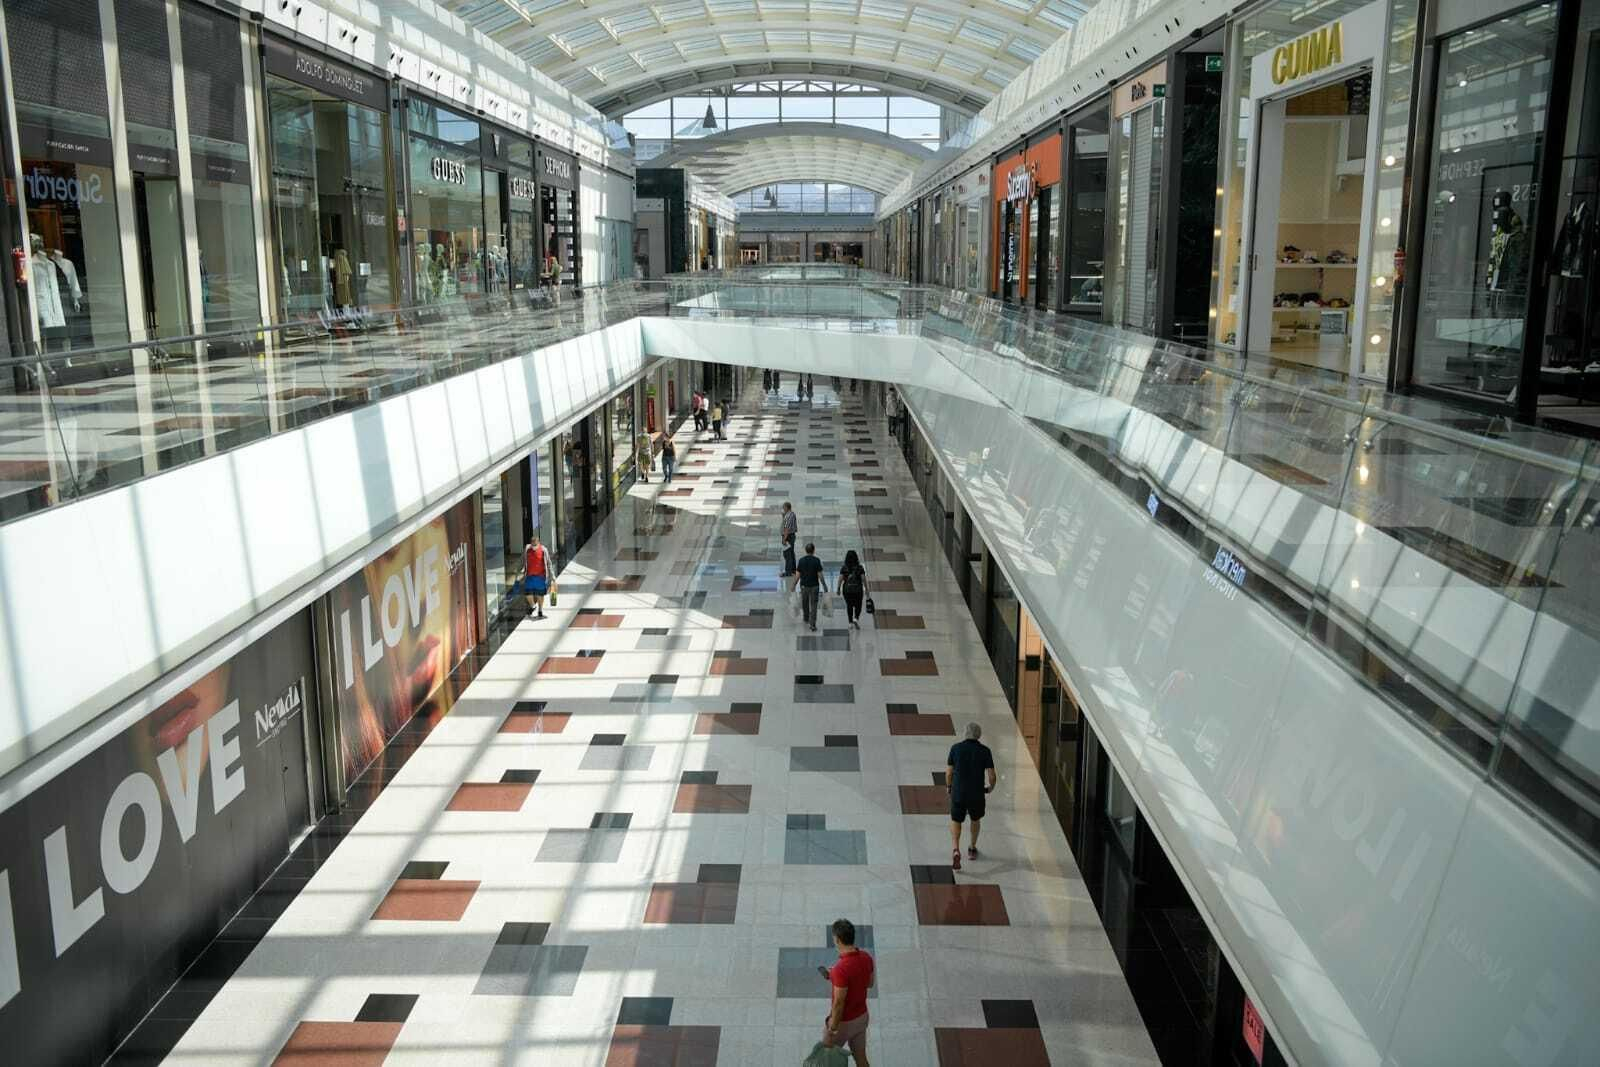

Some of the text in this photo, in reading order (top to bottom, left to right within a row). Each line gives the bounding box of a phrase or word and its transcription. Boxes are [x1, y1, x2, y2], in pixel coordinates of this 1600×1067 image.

[296, 58, 364, 95] ADOLFO DOMINGUEZ
[432, 157, 466, 185] GUESS
[545, 156, 570, 179] SEPHORA
[512, 176, 535, 200] GUESS
[341, 544, 441, 689] I LOVE
[43, 699, 246, 959] LOVE
